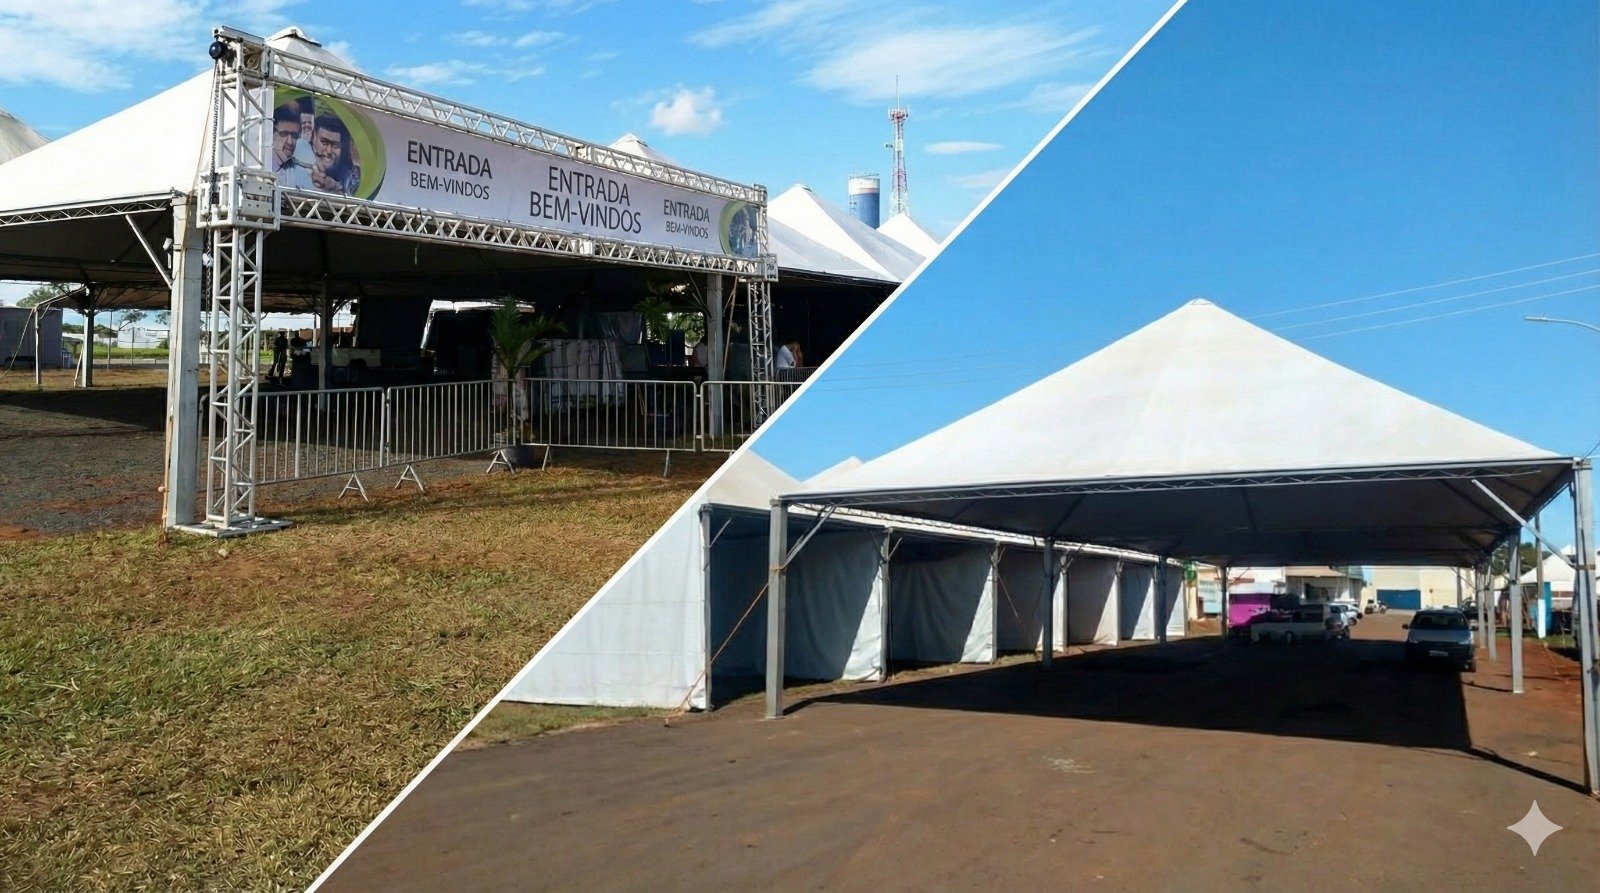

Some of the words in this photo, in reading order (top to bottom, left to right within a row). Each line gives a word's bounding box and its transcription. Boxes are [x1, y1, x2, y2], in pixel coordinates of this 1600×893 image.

[407, 140, 493, 179] ENTRADA
[410, 171, 490, 200] BEM-VINDOS
[548, 165, 631, 206] ENTRADA
[529, 191, 642, 234] BEM-VINDOS
[663, 199, 710, 223] ENTRADA
[665, 220, 709, 239] BEM-VINDOS
